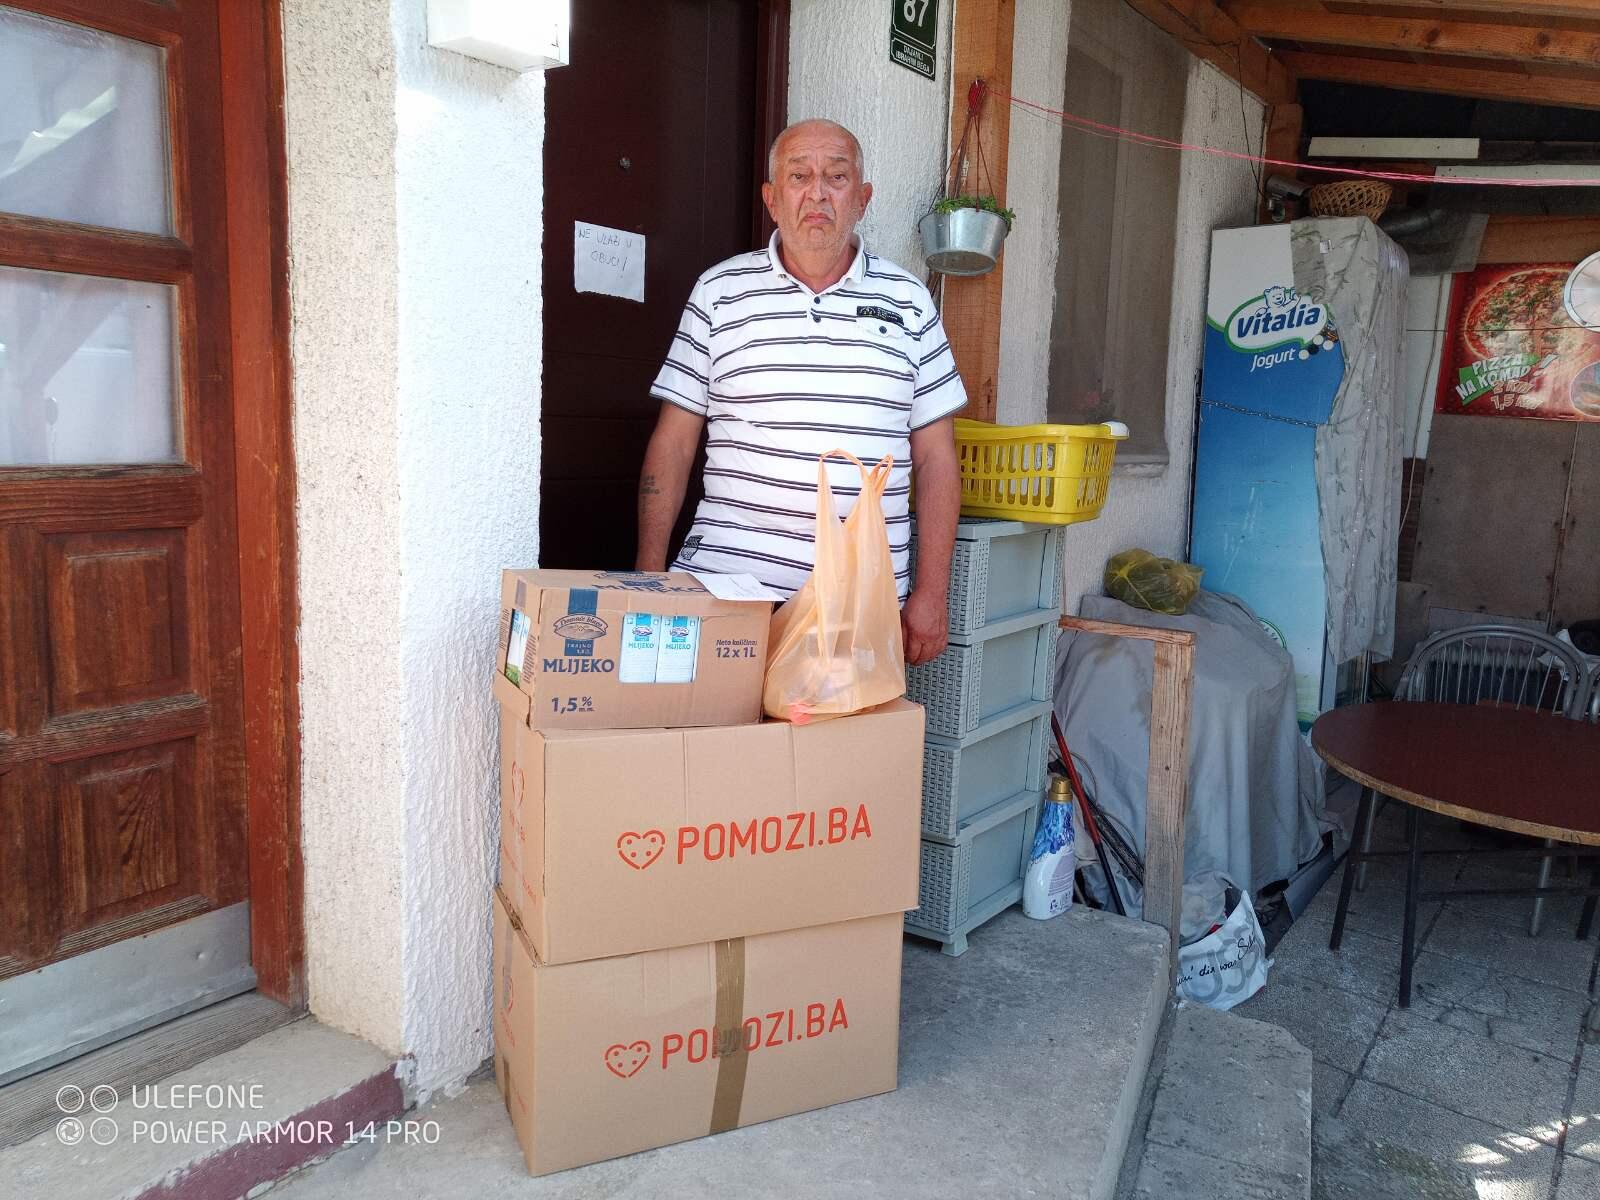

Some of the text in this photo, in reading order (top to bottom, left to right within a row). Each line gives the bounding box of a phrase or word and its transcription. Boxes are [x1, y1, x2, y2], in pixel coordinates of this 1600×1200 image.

[903, 0, 929, 27] 87
[578, 228, 591, 239] NE
[1237, 303, 1321, 338] Vitalia
[1472, 353, 1523, 375] PIZZA
[1455, 379, 1477, 400] NA
[716, 647, 730, 658] 12
[743, 647, 756, 658] 1L
[543, 658, 615, 675] MLIJEKO
[677, 803, 872, 865] POMOZI.BA
